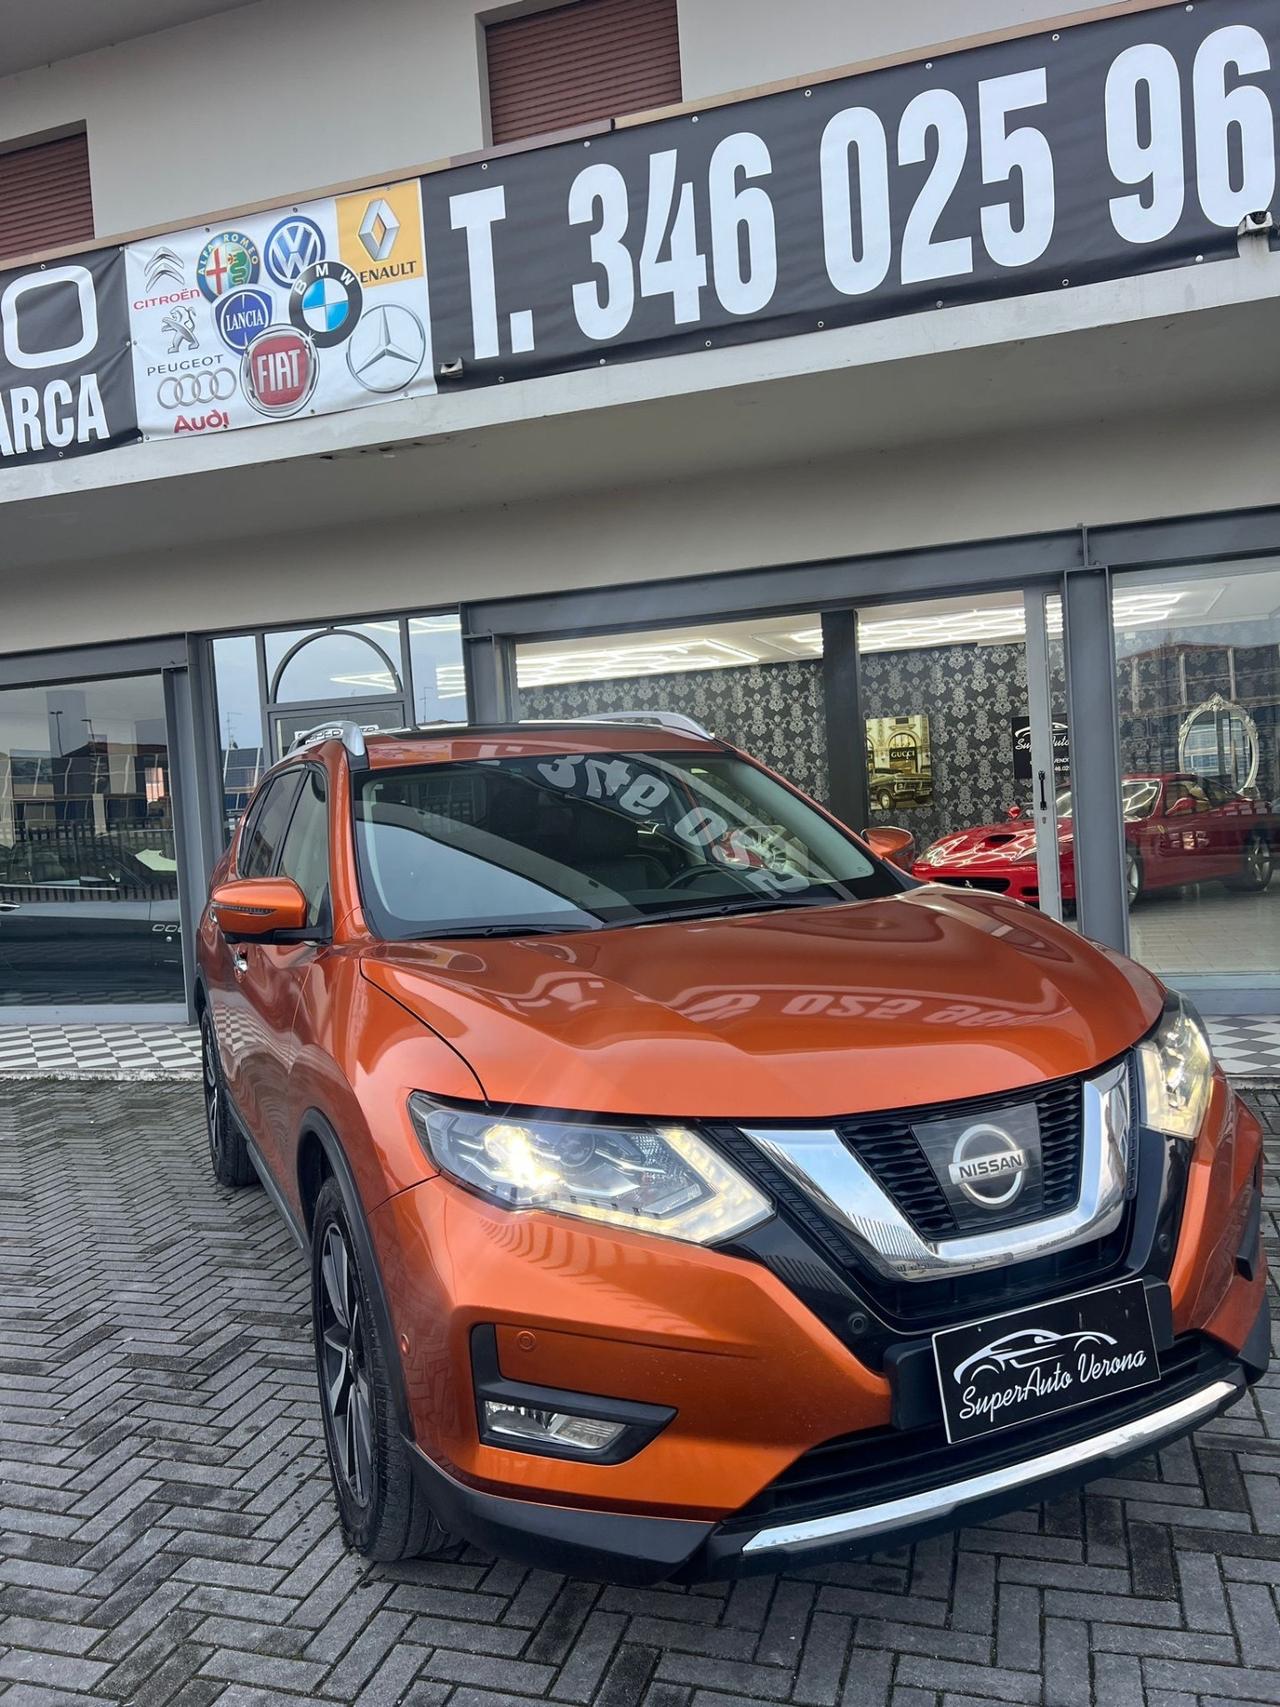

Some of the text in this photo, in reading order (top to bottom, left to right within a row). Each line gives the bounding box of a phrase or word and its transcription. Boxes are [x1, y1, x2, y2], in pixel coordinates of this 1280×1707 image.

[449, 24, 1276, 360] T. 346 025 96
[198, 233, 259, 276] ALFA ROMEO
[294, 262, 355, 295] BMW
[359, 260, 417, 284] ENAULT
[225, 309, 264, 332] LANCIA
[147, 353, 224, 377] PEUGEOT
[256, 348, 301, 394] FIAT
[891, 750, 915, 760] GUCCI
[958, 1152, 1024, 1179] NISSAN
[1077, 1349, 1147, 1384] Verona
